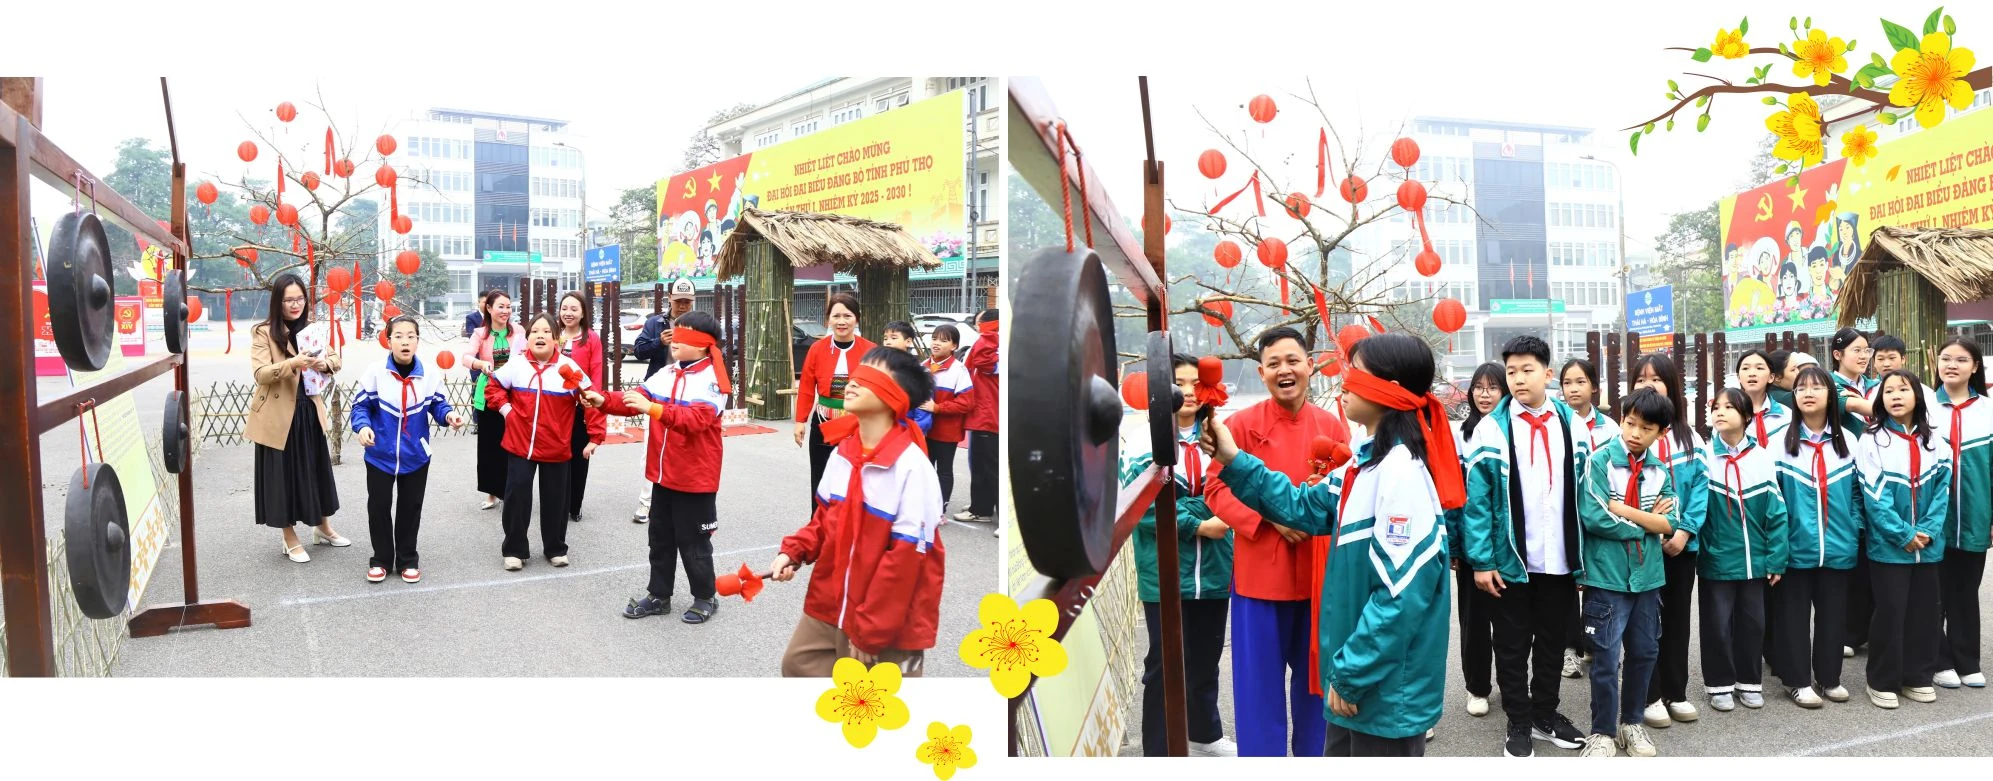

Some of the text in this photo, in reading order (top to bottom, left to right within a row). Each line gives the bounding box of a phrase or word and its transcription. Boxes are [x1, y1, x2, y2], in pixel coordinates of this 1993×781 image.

[794, 140, 891, 176] NHIỆT LIỆT CHÀO MỪNG
[1906, 160, 1937, 185] NHIỆT
[1939, 152, 1963, 176] LIỆT
[767, 155, 934, 203] ĐẠI HỘI ĐẠI BIỂU ĐẢNG BỘ TỈNH PHÚ THỌ
[819, 194, 846, 213] NHIỆM
[860, 189, 879, 205] 2025
[886, 184, 906, 201] 2030
[1870, 203, 1886, 222] ĐẠI
[1888, 196, 1904, 218] HỘI
[1906, 193, 1924, 214] ĐẠI
[1926, 180, 1951, 207] BIỂU
[1953, 176, 1987, 200] ĐẢNG
